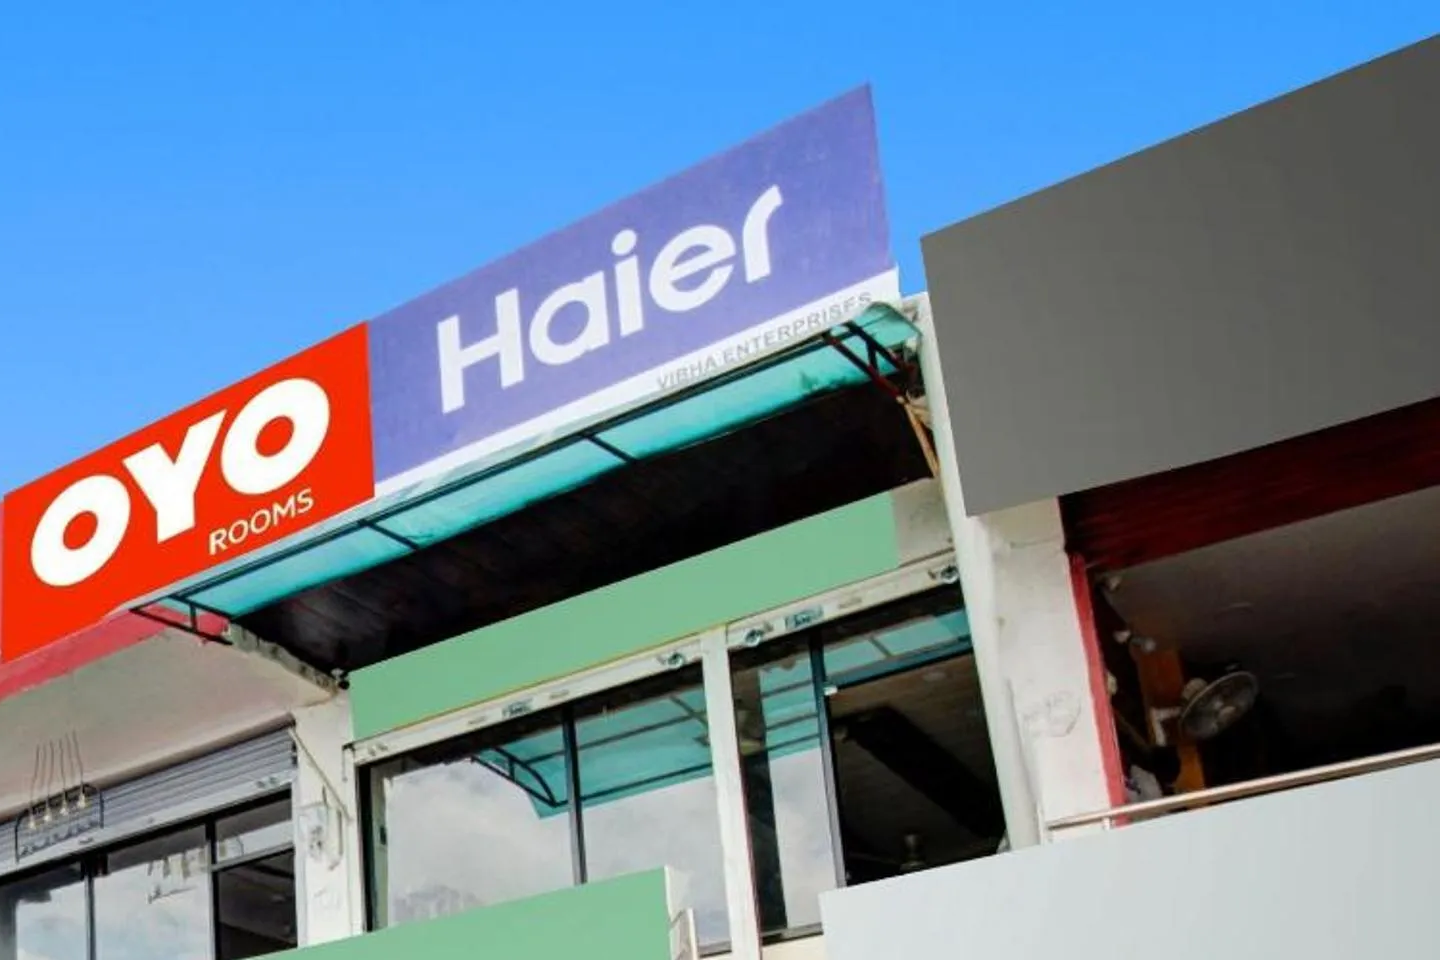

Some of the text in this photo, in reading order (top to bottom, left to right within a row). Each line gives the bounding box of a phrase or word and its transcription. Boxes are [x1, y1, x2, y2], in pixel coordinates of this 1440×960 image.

[436, 184, 784, 415] Haier
[657, 291, 873, 389] VIBHA ENTERPRISES
[30, 377, 330, 587] OYO
[208, 488, 315, 556] ROOMS
